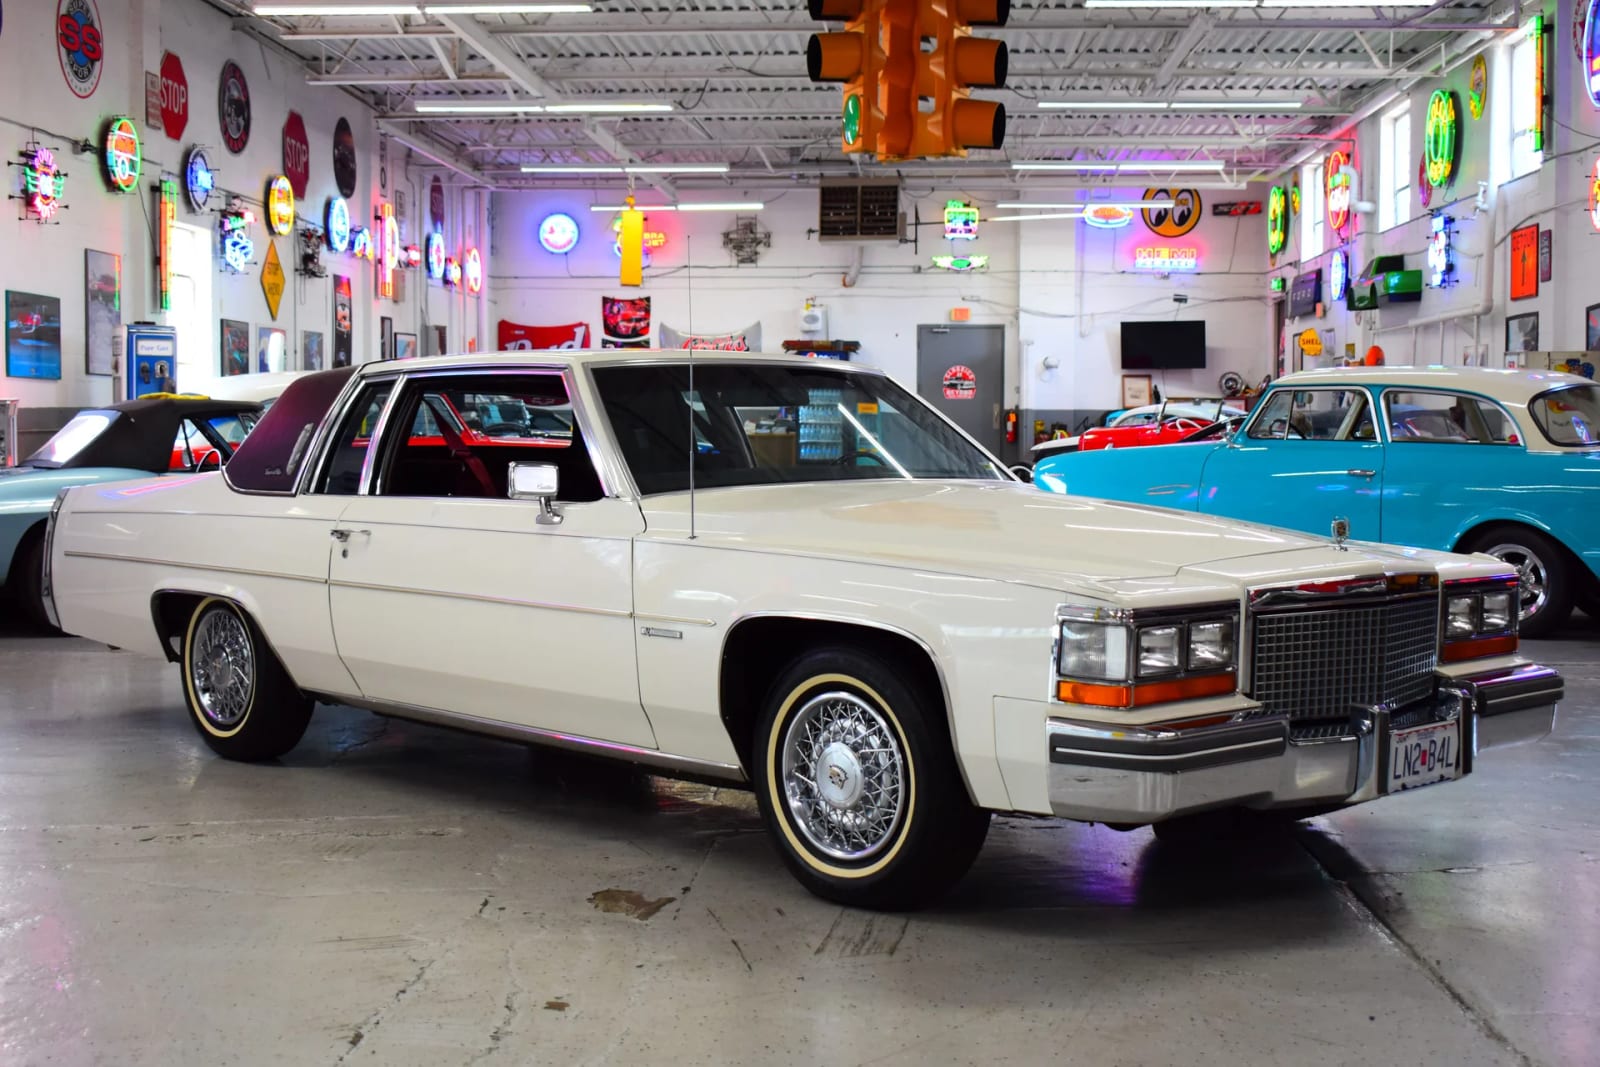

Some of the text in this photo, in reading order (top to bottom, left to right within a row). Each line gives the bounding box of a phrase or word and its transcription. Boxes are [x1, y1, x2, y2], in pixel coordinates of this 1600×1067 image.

[59, 14, 102, 61] SS
[160, 77, 187, 115] STOP
[286, 137, 308, 174] STOP
[643, 232, 665, 240] BRA
[1135, 247, 1197, 260] HEMI
